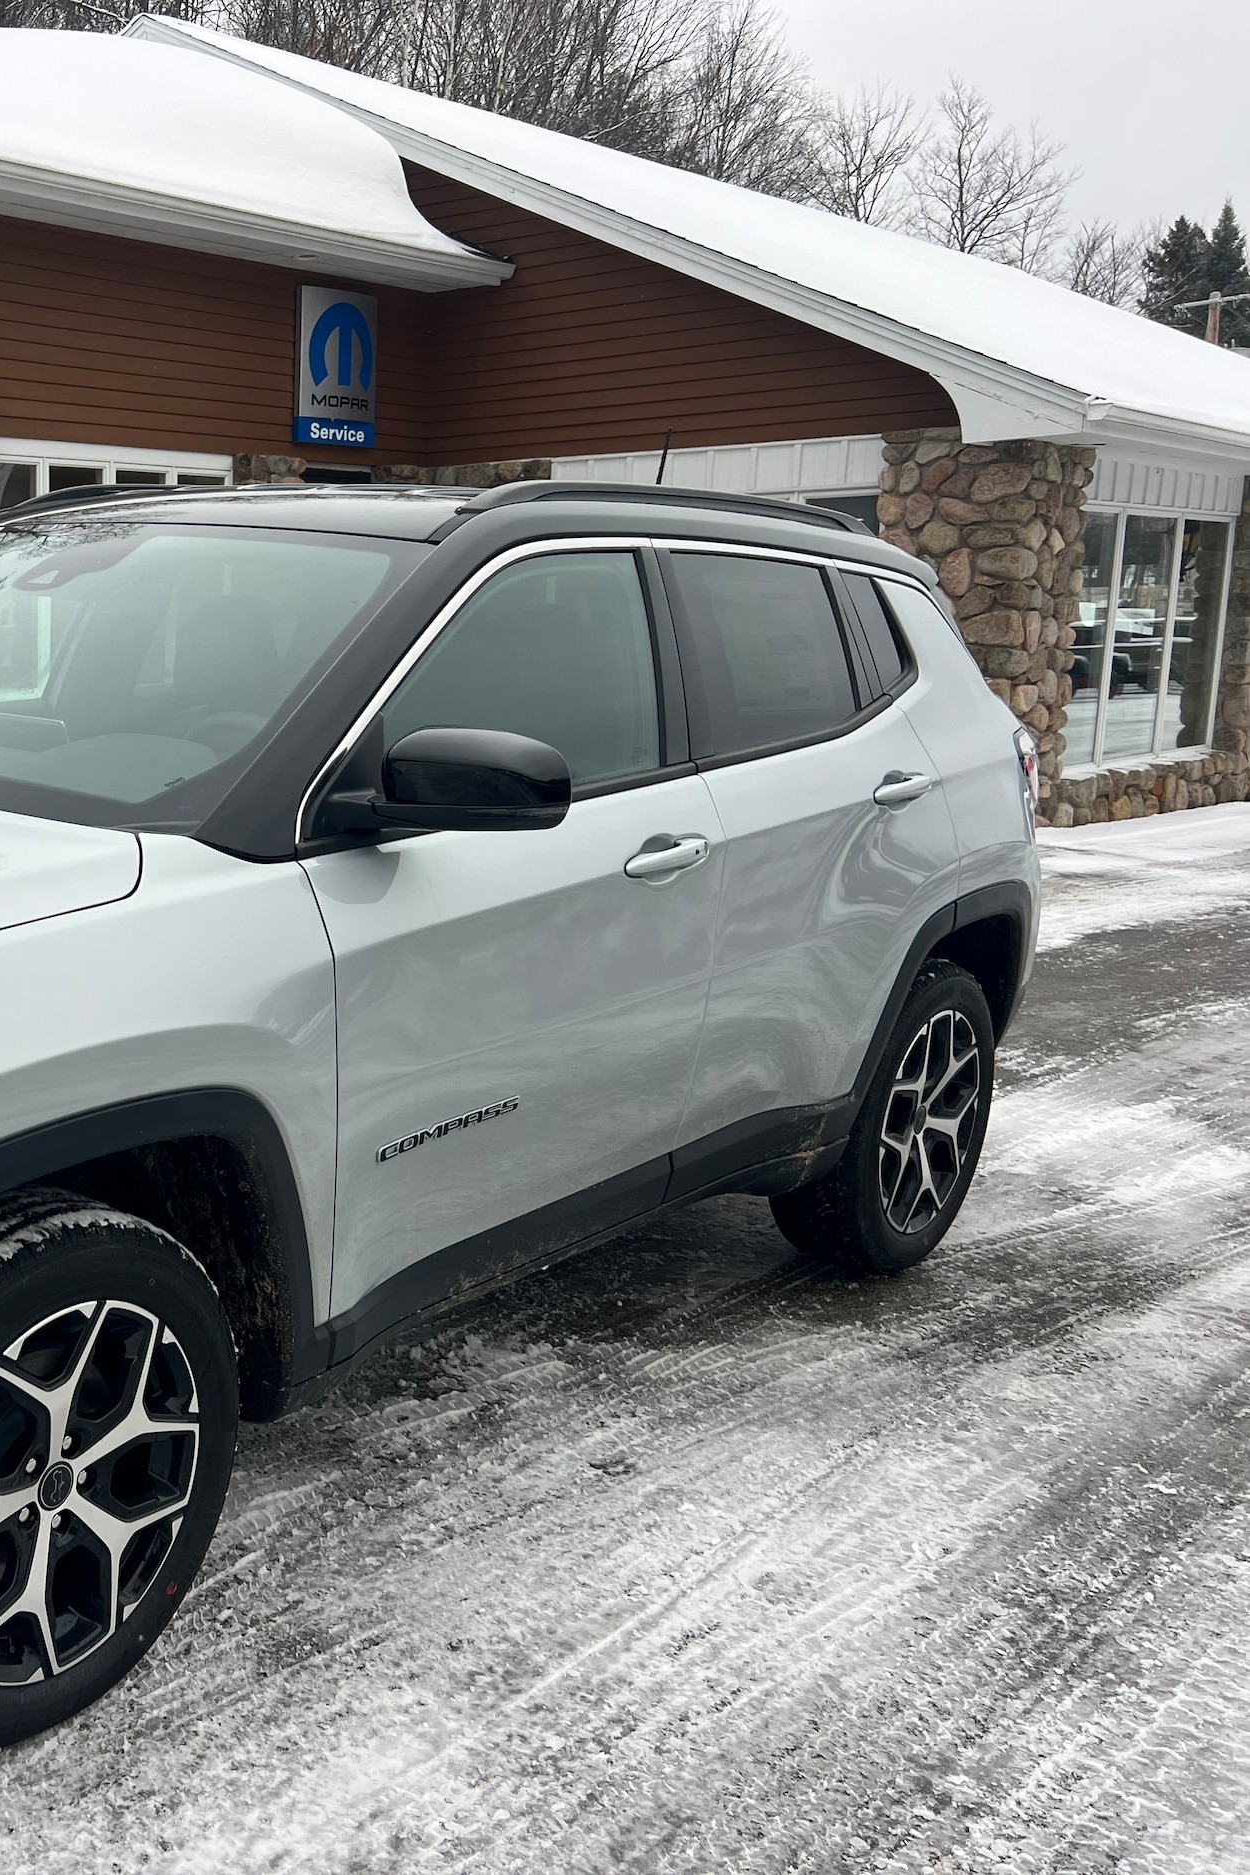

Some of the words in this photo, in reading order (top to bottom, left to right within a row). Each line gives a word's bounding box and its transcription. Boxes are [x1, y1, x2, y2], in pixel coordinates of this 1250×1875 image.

[311, 394, 369, 411] MOPAR
[310, 422, 365, 443] Service
[376, 1094, 520, 1163] COMPASS
